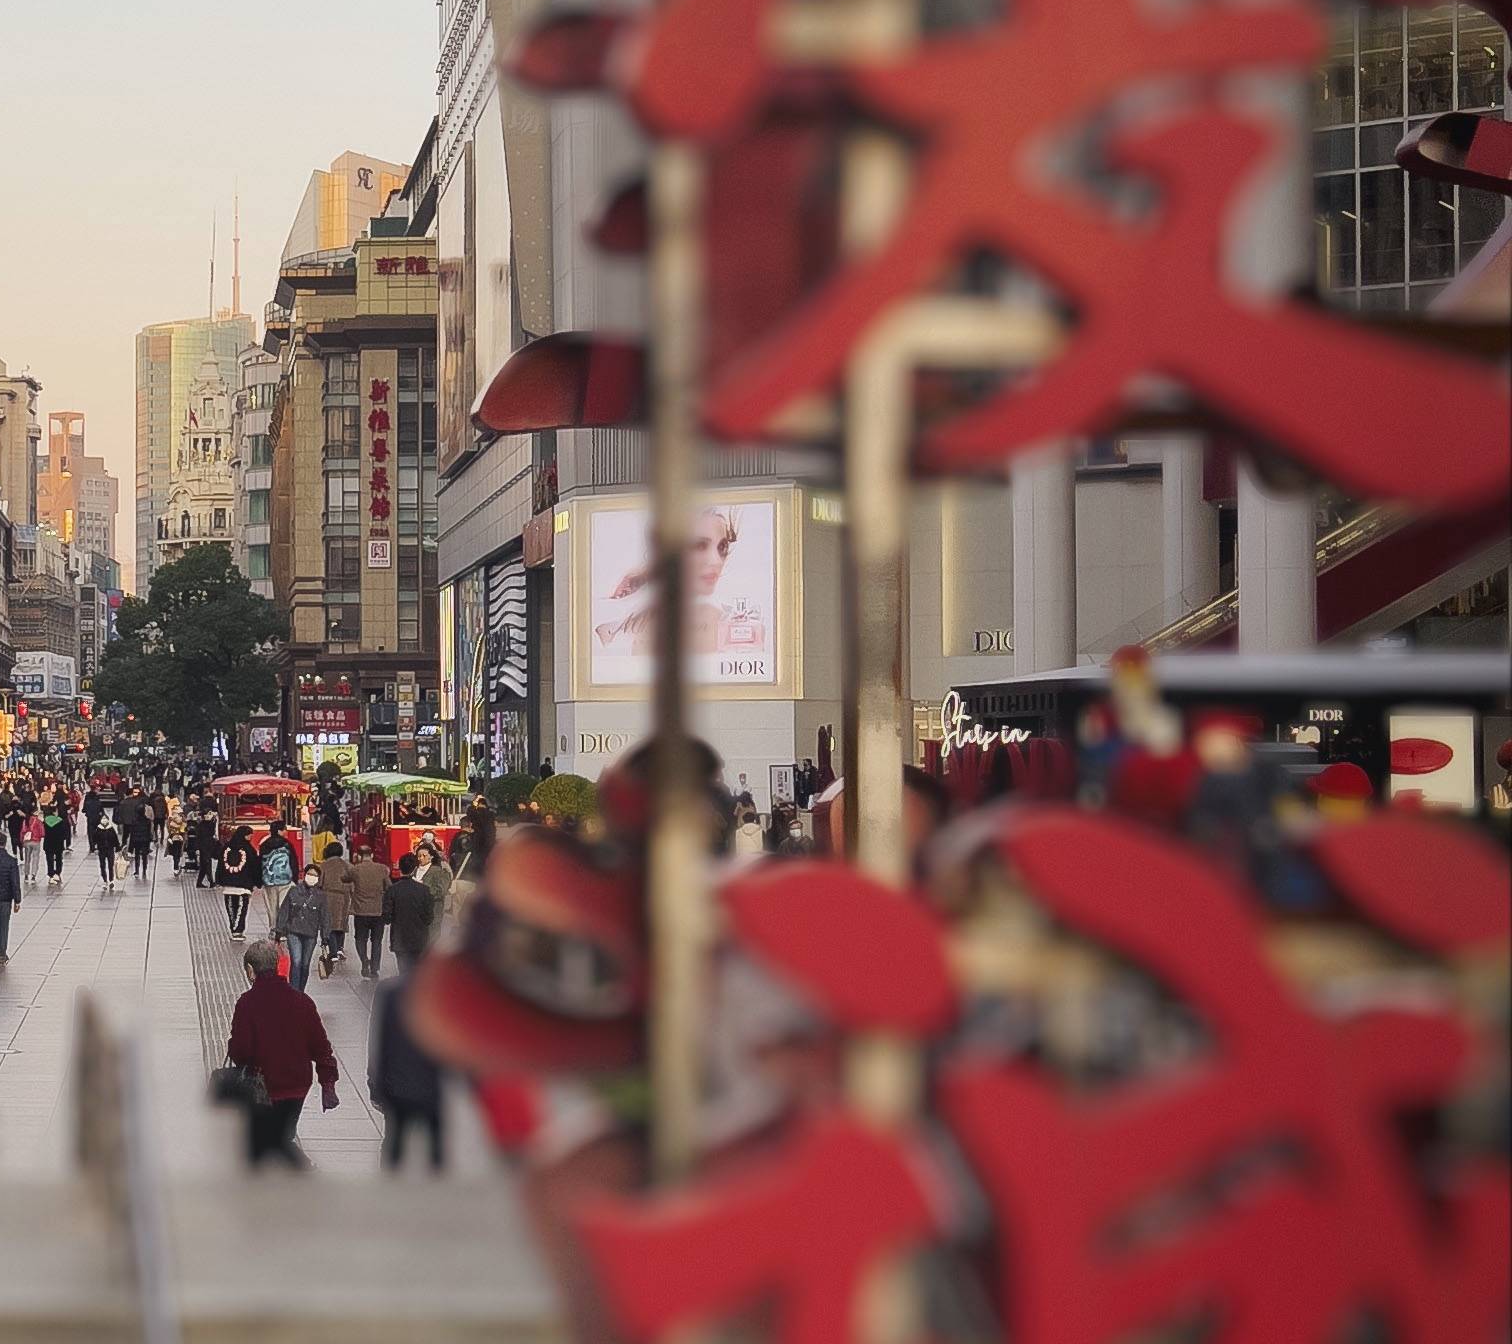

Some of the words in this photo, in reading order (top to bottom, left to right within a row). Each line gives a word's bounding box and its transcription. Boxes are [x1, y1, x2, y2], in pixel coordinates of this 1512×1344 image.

[974, 630, 1014, 653] DI
[720, 660, 766, 676] DIOR
[1309, 709, 1344, 721] DIOR
